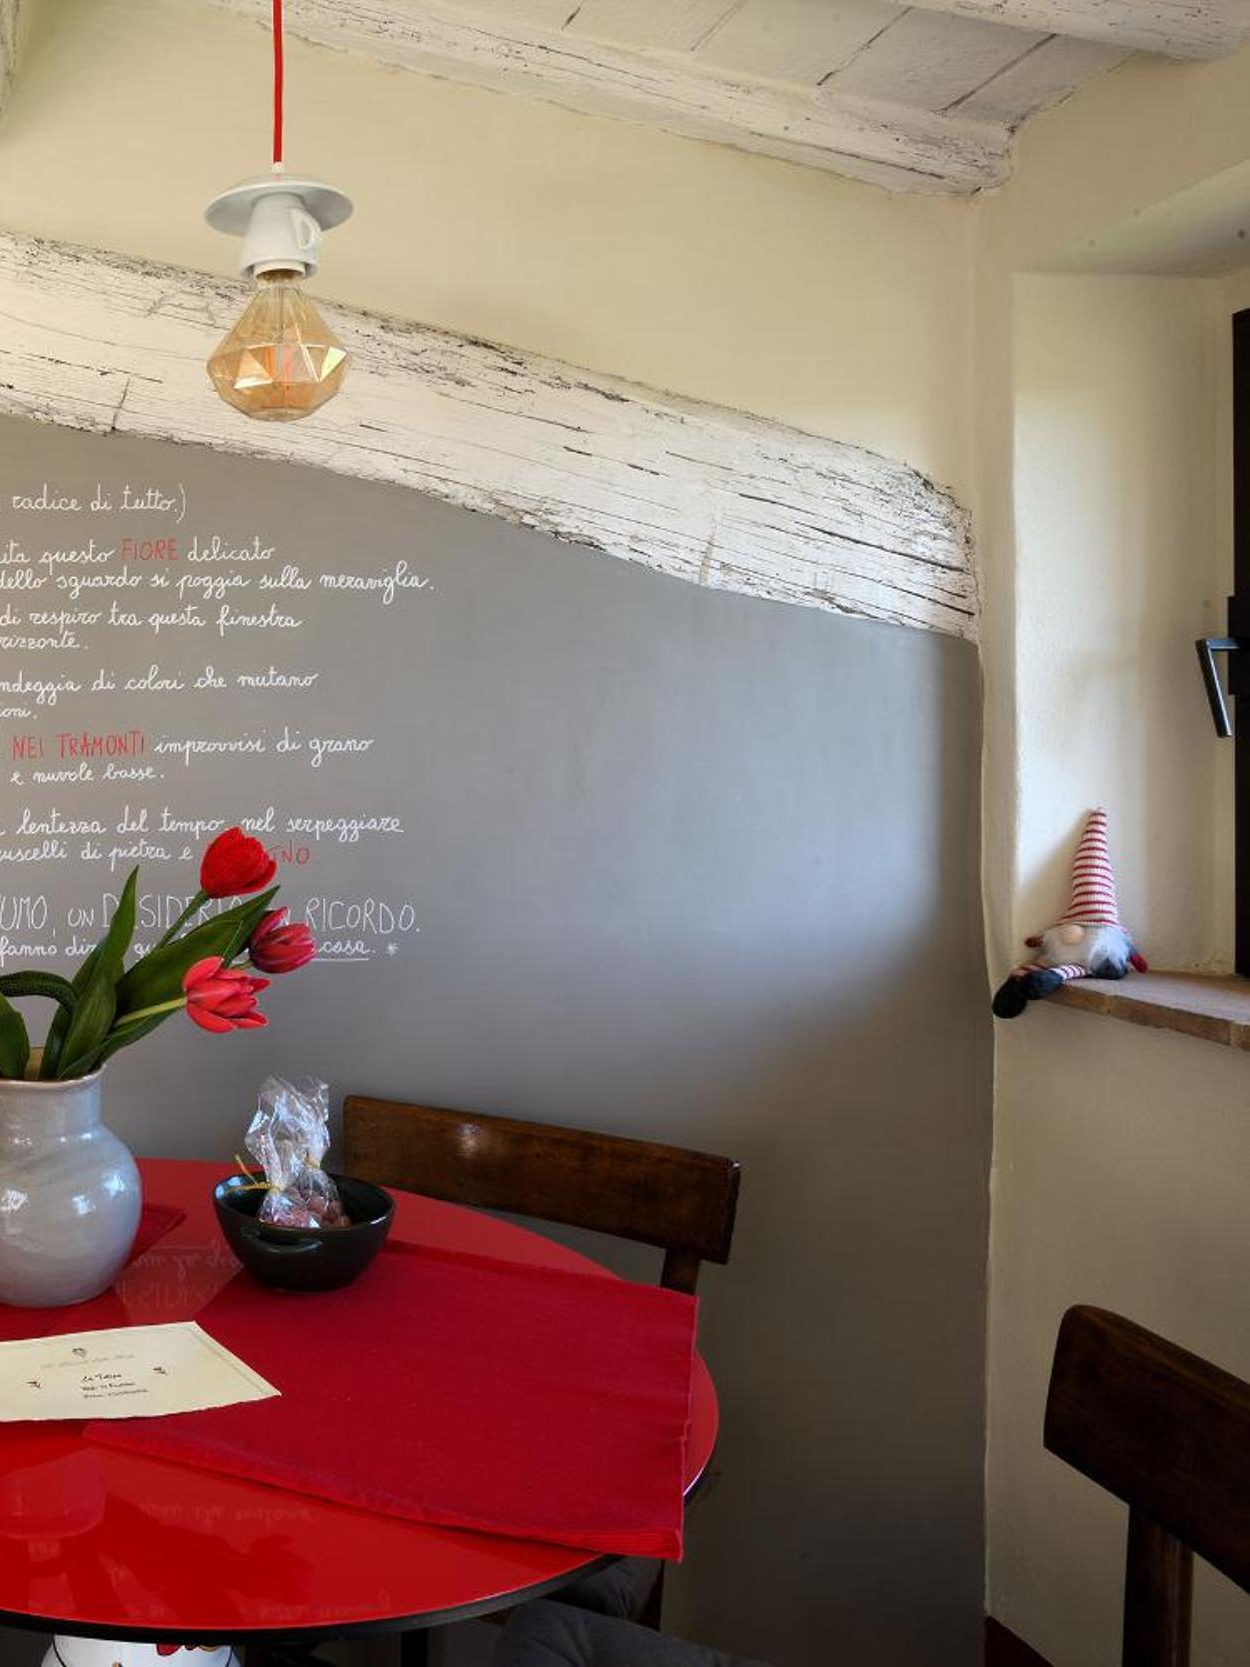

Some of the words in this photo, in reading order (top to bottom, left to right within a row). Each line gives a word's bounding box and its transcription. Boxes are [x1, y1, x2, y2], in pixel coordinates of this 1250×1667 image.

[13, 478, 81, 511] radice
[91, 483, 112, 511] di
[38, 539, 116, 575] questo
[121, 538, 179, 561] FIORE
[188, 536, 275, 562] delicato
[56, 565, 142, 599] sguardo
[150, 567, 170, 587] si
[175, 570, 250, 600] poggia
[259, 565, 311, 590] sulla
[319, 560, 435, 604] meraviglia.
[0, 604, 21, 626] di
[30, 607, 102, 634] respiro
[109, 601, 142, 626] tra
[147, 605, 206, 634] questa
[216, 604, 302, 637] finestra
[91, 669, 116, 691] di
[124, 665, 185, 691] colori
[194, 666, 227, 690] che
[237, 666, 319, 688] mutano
[12, 735, 44, 760] NEI
[57, 730, 144, 759] TRAMONTI
[153, 730, 266, 767] improvvisi
[276, 726, 301, 752] di
[309, 738, 374, 768] grano
[10, 771, 24, 786] e
[33, 761, 94, 781] nuvole
[102, 762, 165, 781] basse.
[16, 808, 107, 834] lentezza
[116, 804, 149, 833] del
[159, 807, 225, 840] tempo
[238, 806, 275, 833] nel
[286, 812, 404, 842] serpeggiare
[81, 840, 102, 860] di
[109, 840, 171, 872] pietra
[180, 845, 194, 859] e
[306, 898, 420, 934] RICORDO.
